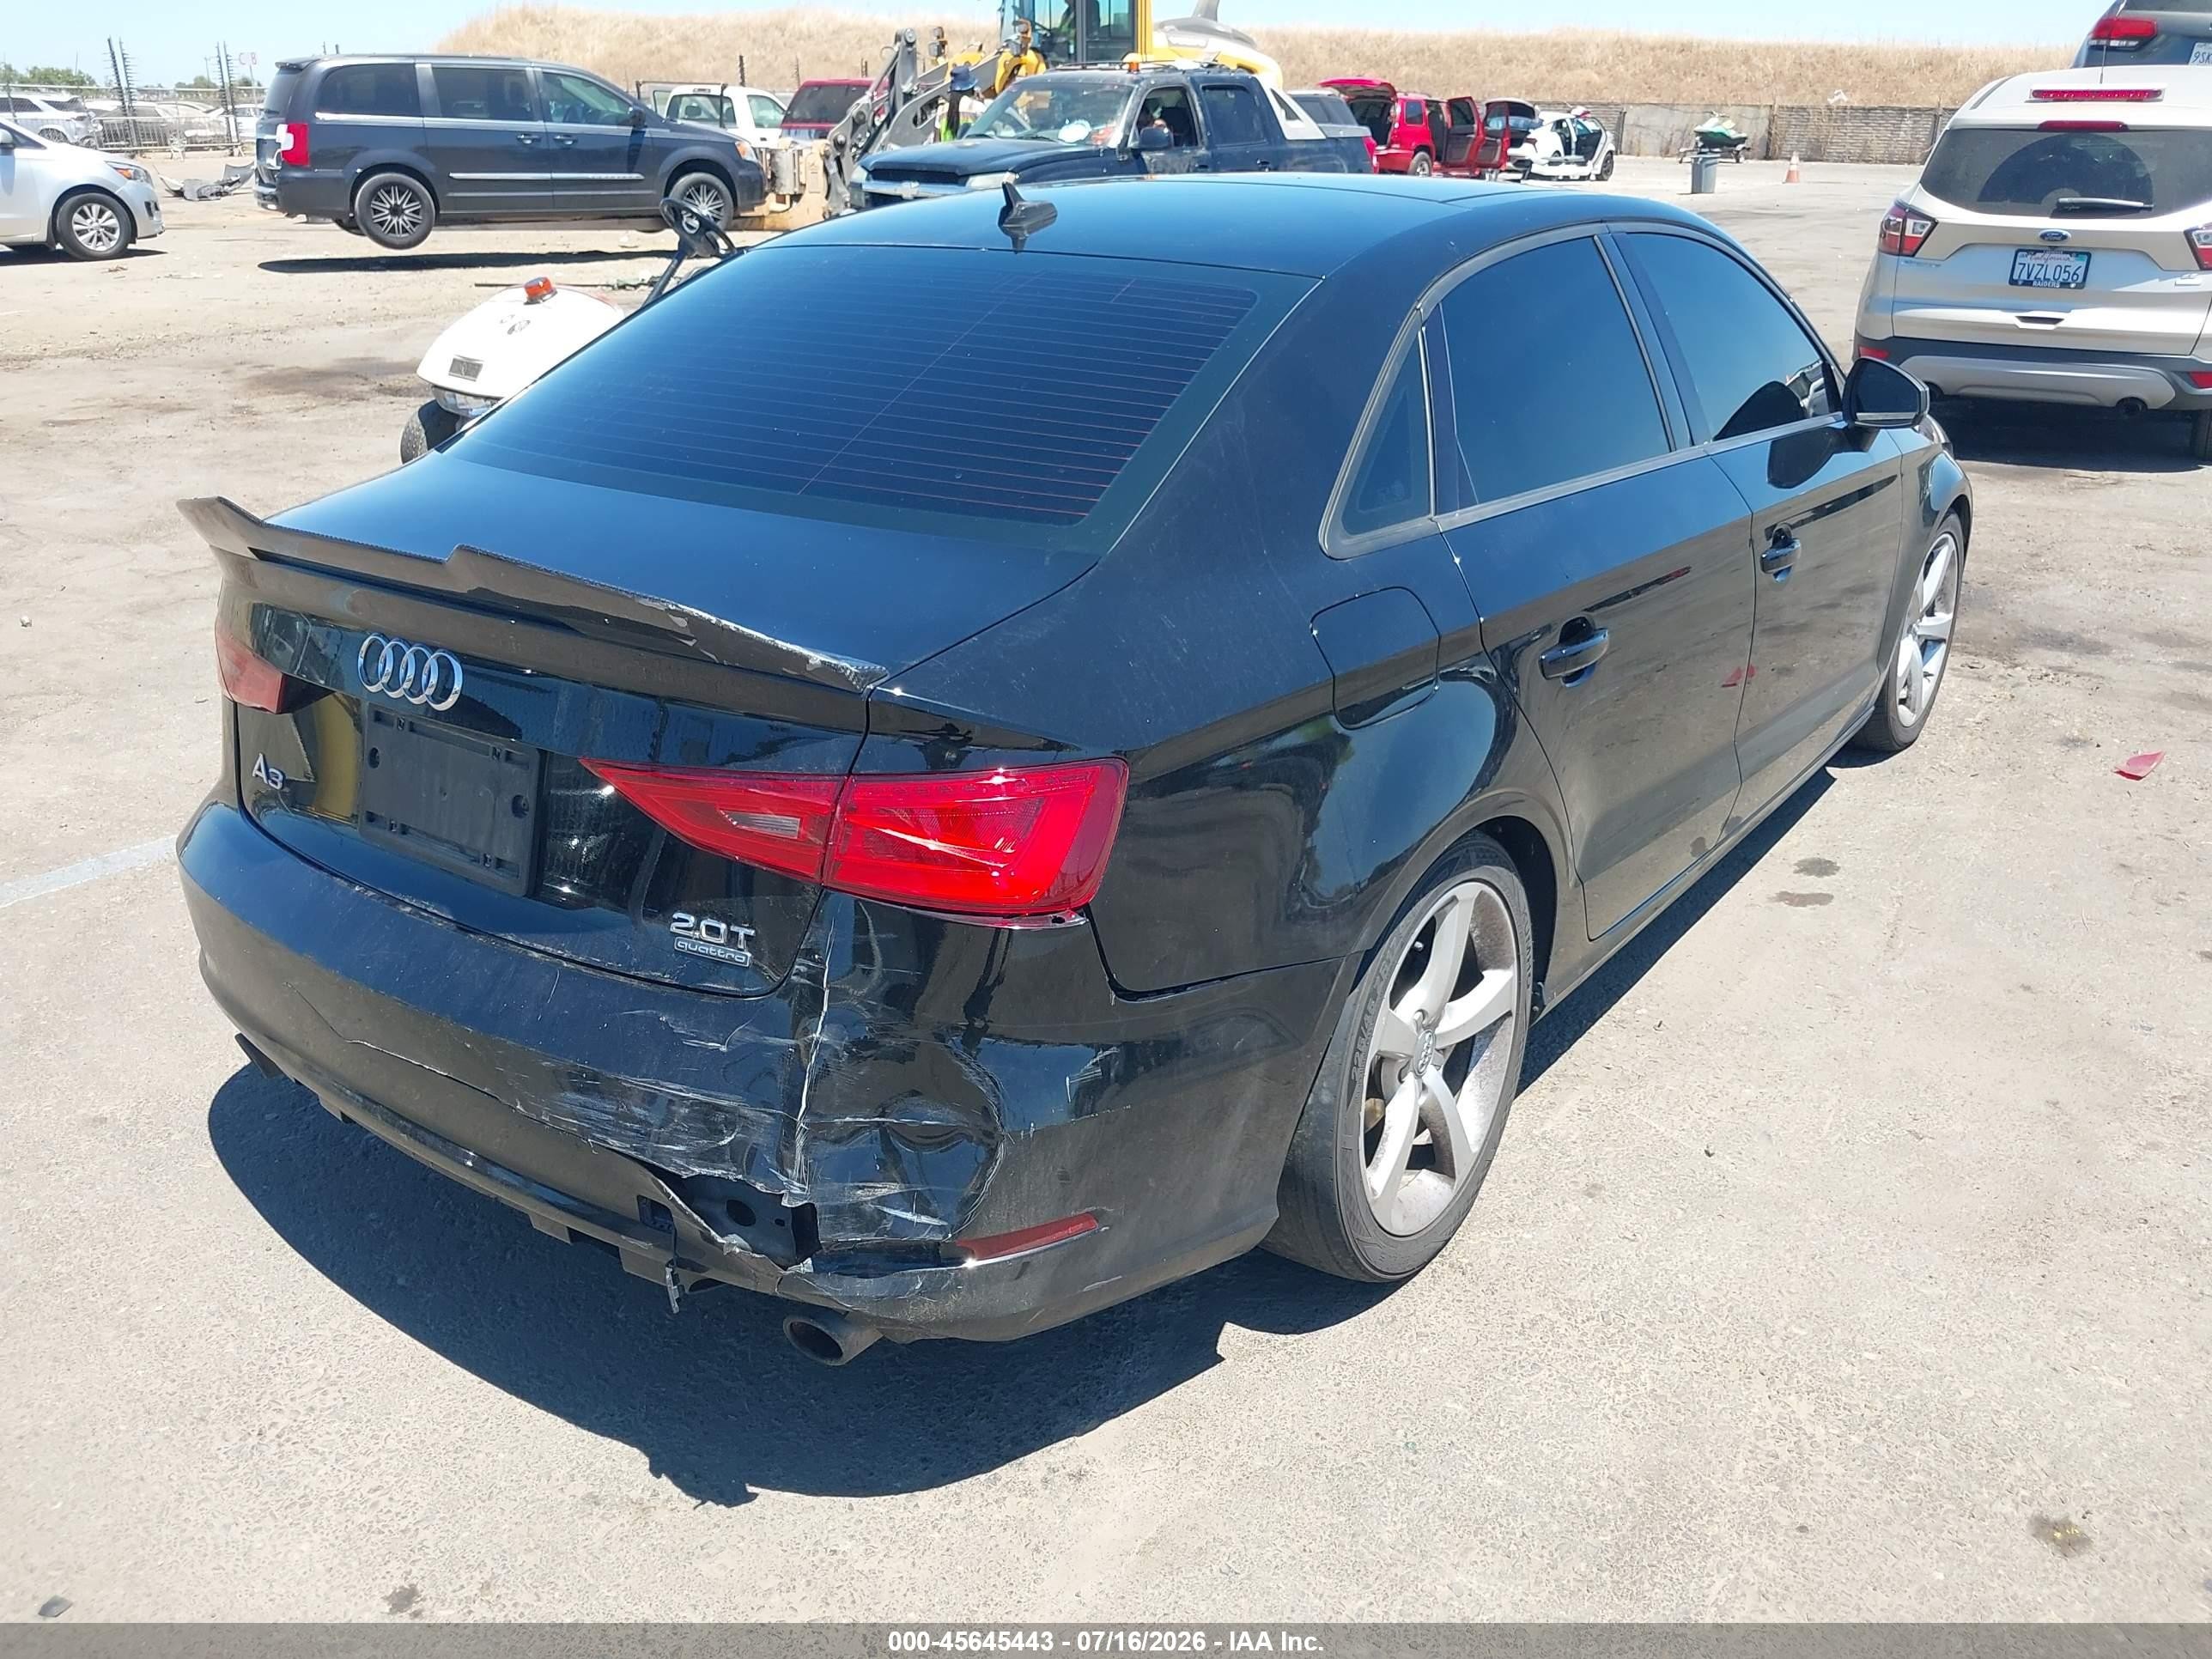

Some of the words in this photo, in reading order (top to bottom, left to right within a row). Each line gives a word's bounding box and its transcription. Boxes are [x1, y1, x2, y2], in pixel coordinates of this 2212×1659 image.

[2018, 262, 2082, 282] 7VZL056
[252, 752, 284, 790] A3
[677, 940, 746, 963] quattro
